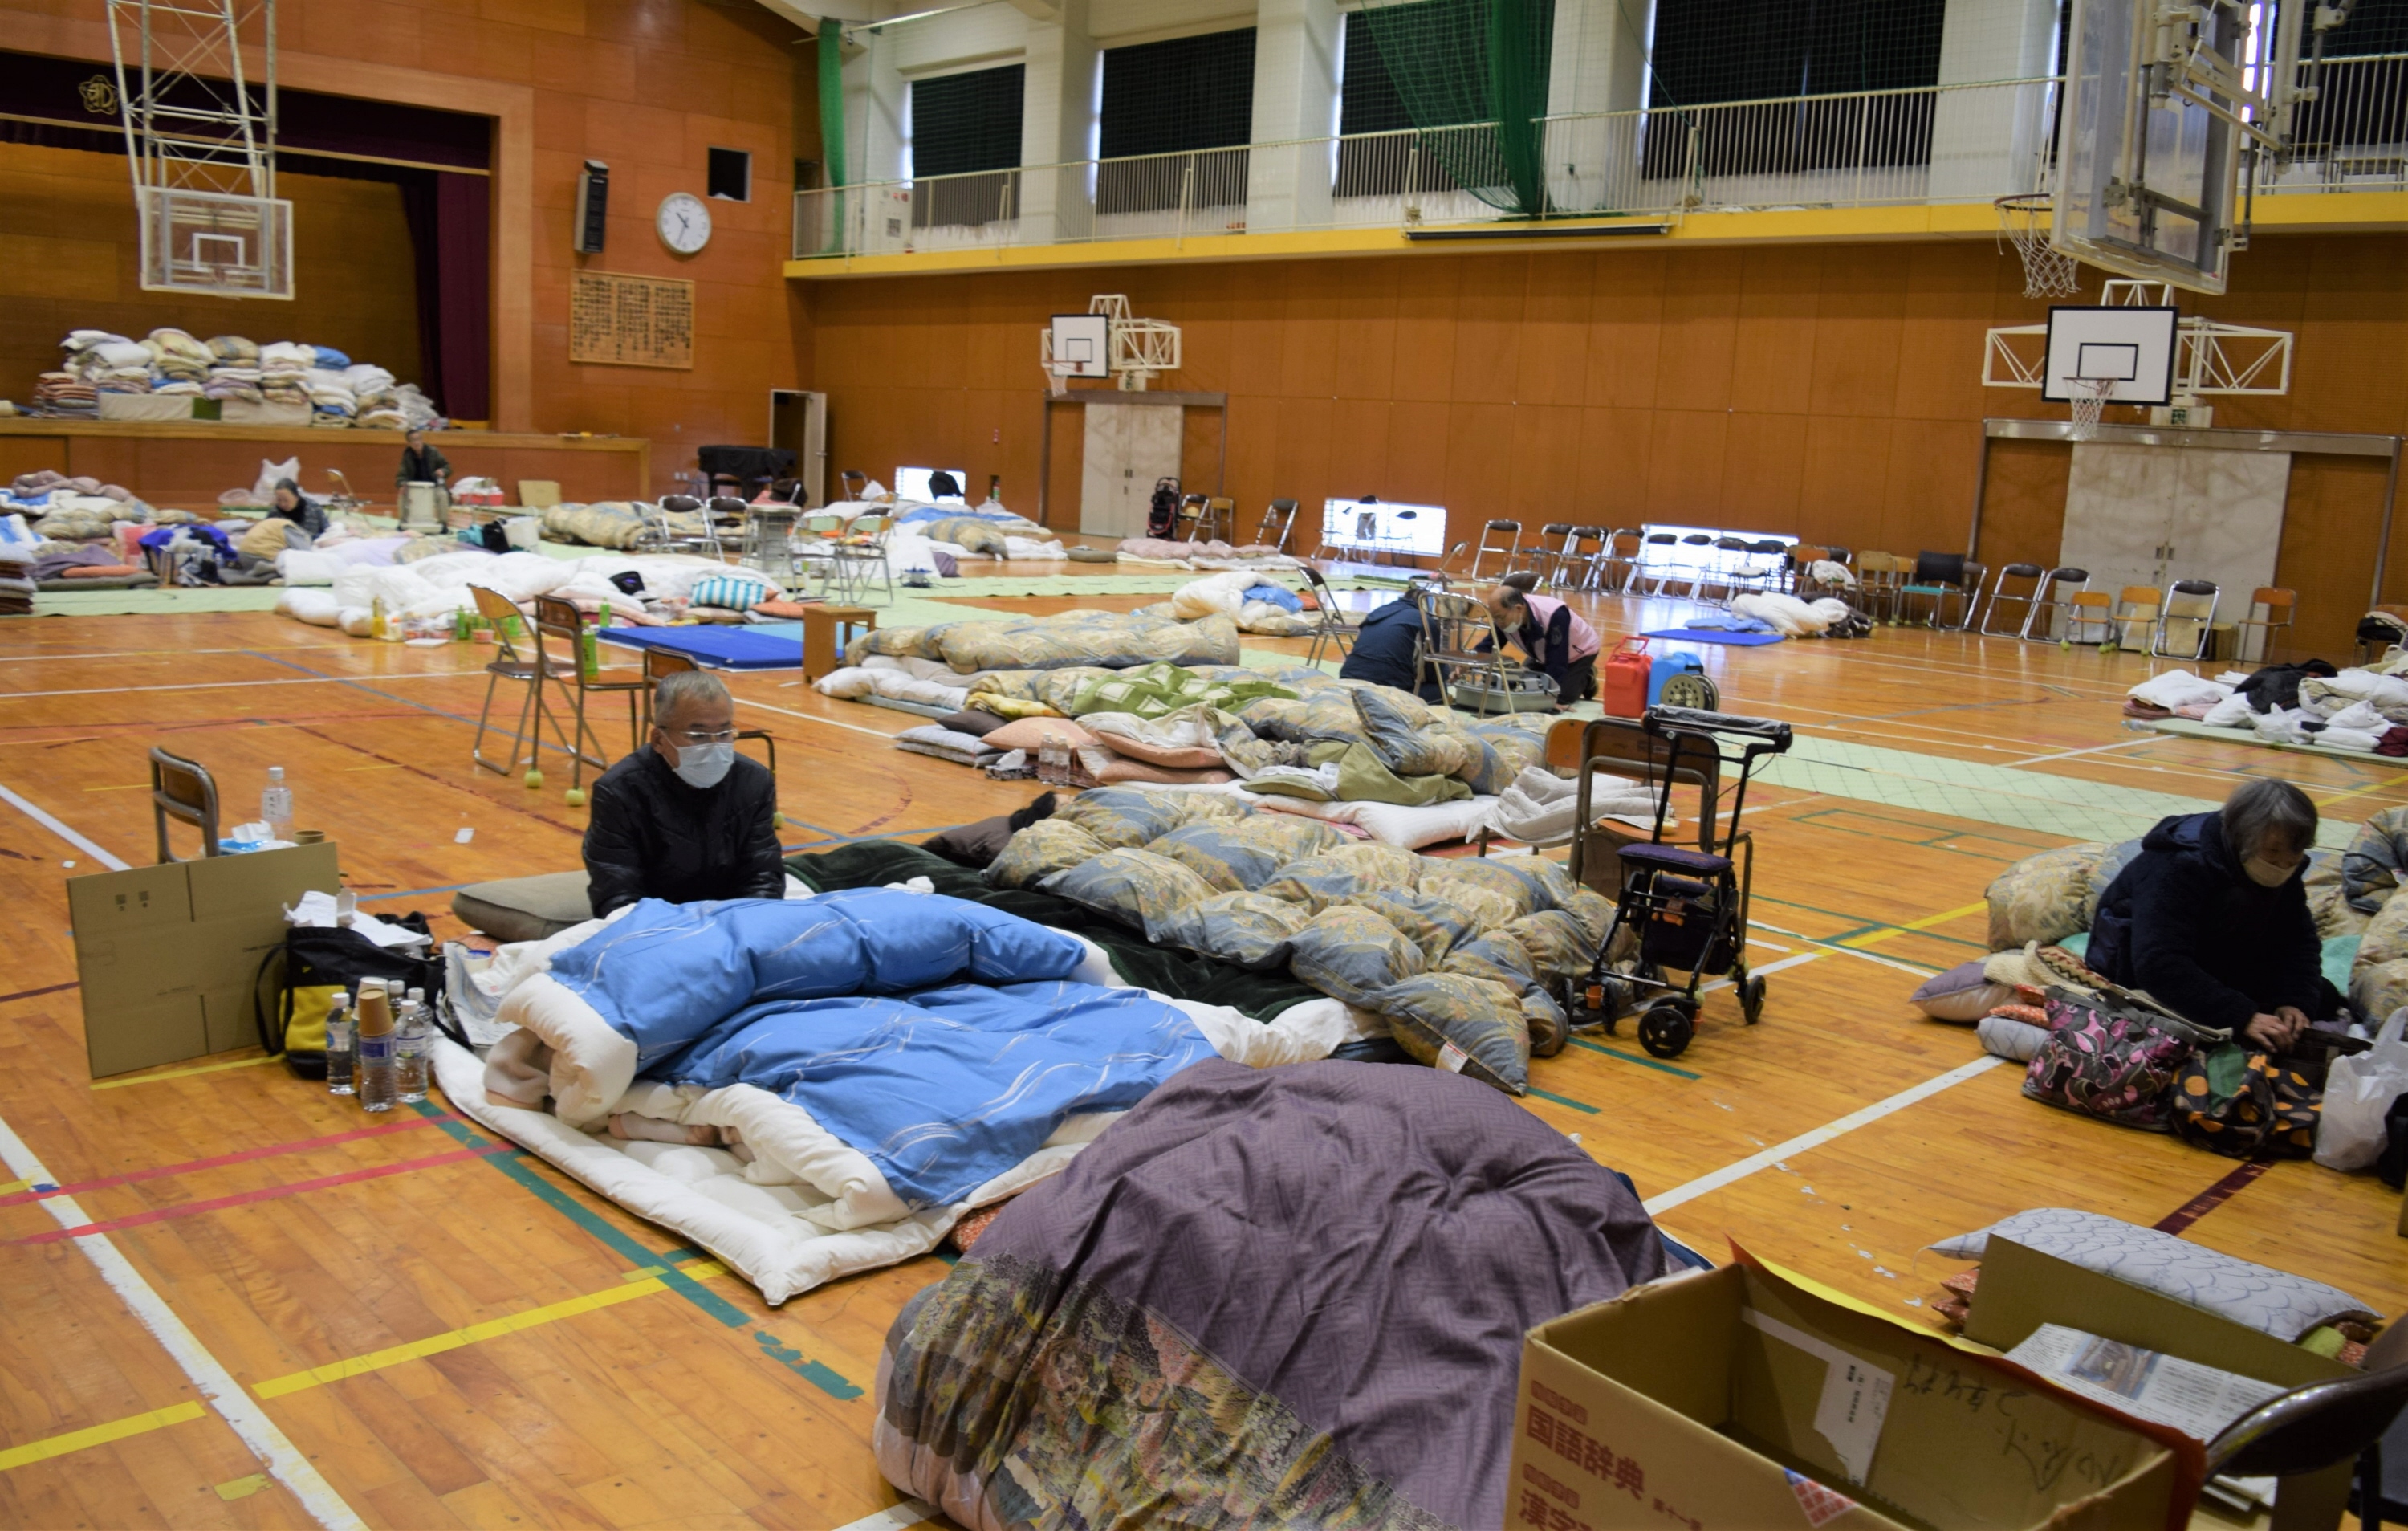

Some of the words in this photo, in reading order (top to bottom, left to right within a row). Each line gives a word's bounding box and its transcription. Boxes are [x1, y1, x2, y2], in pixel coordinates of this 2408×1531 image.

[1526, 1403, 1645, 1500] 国語辞典
[1518, 1488, 1593, 1531] 漢字
